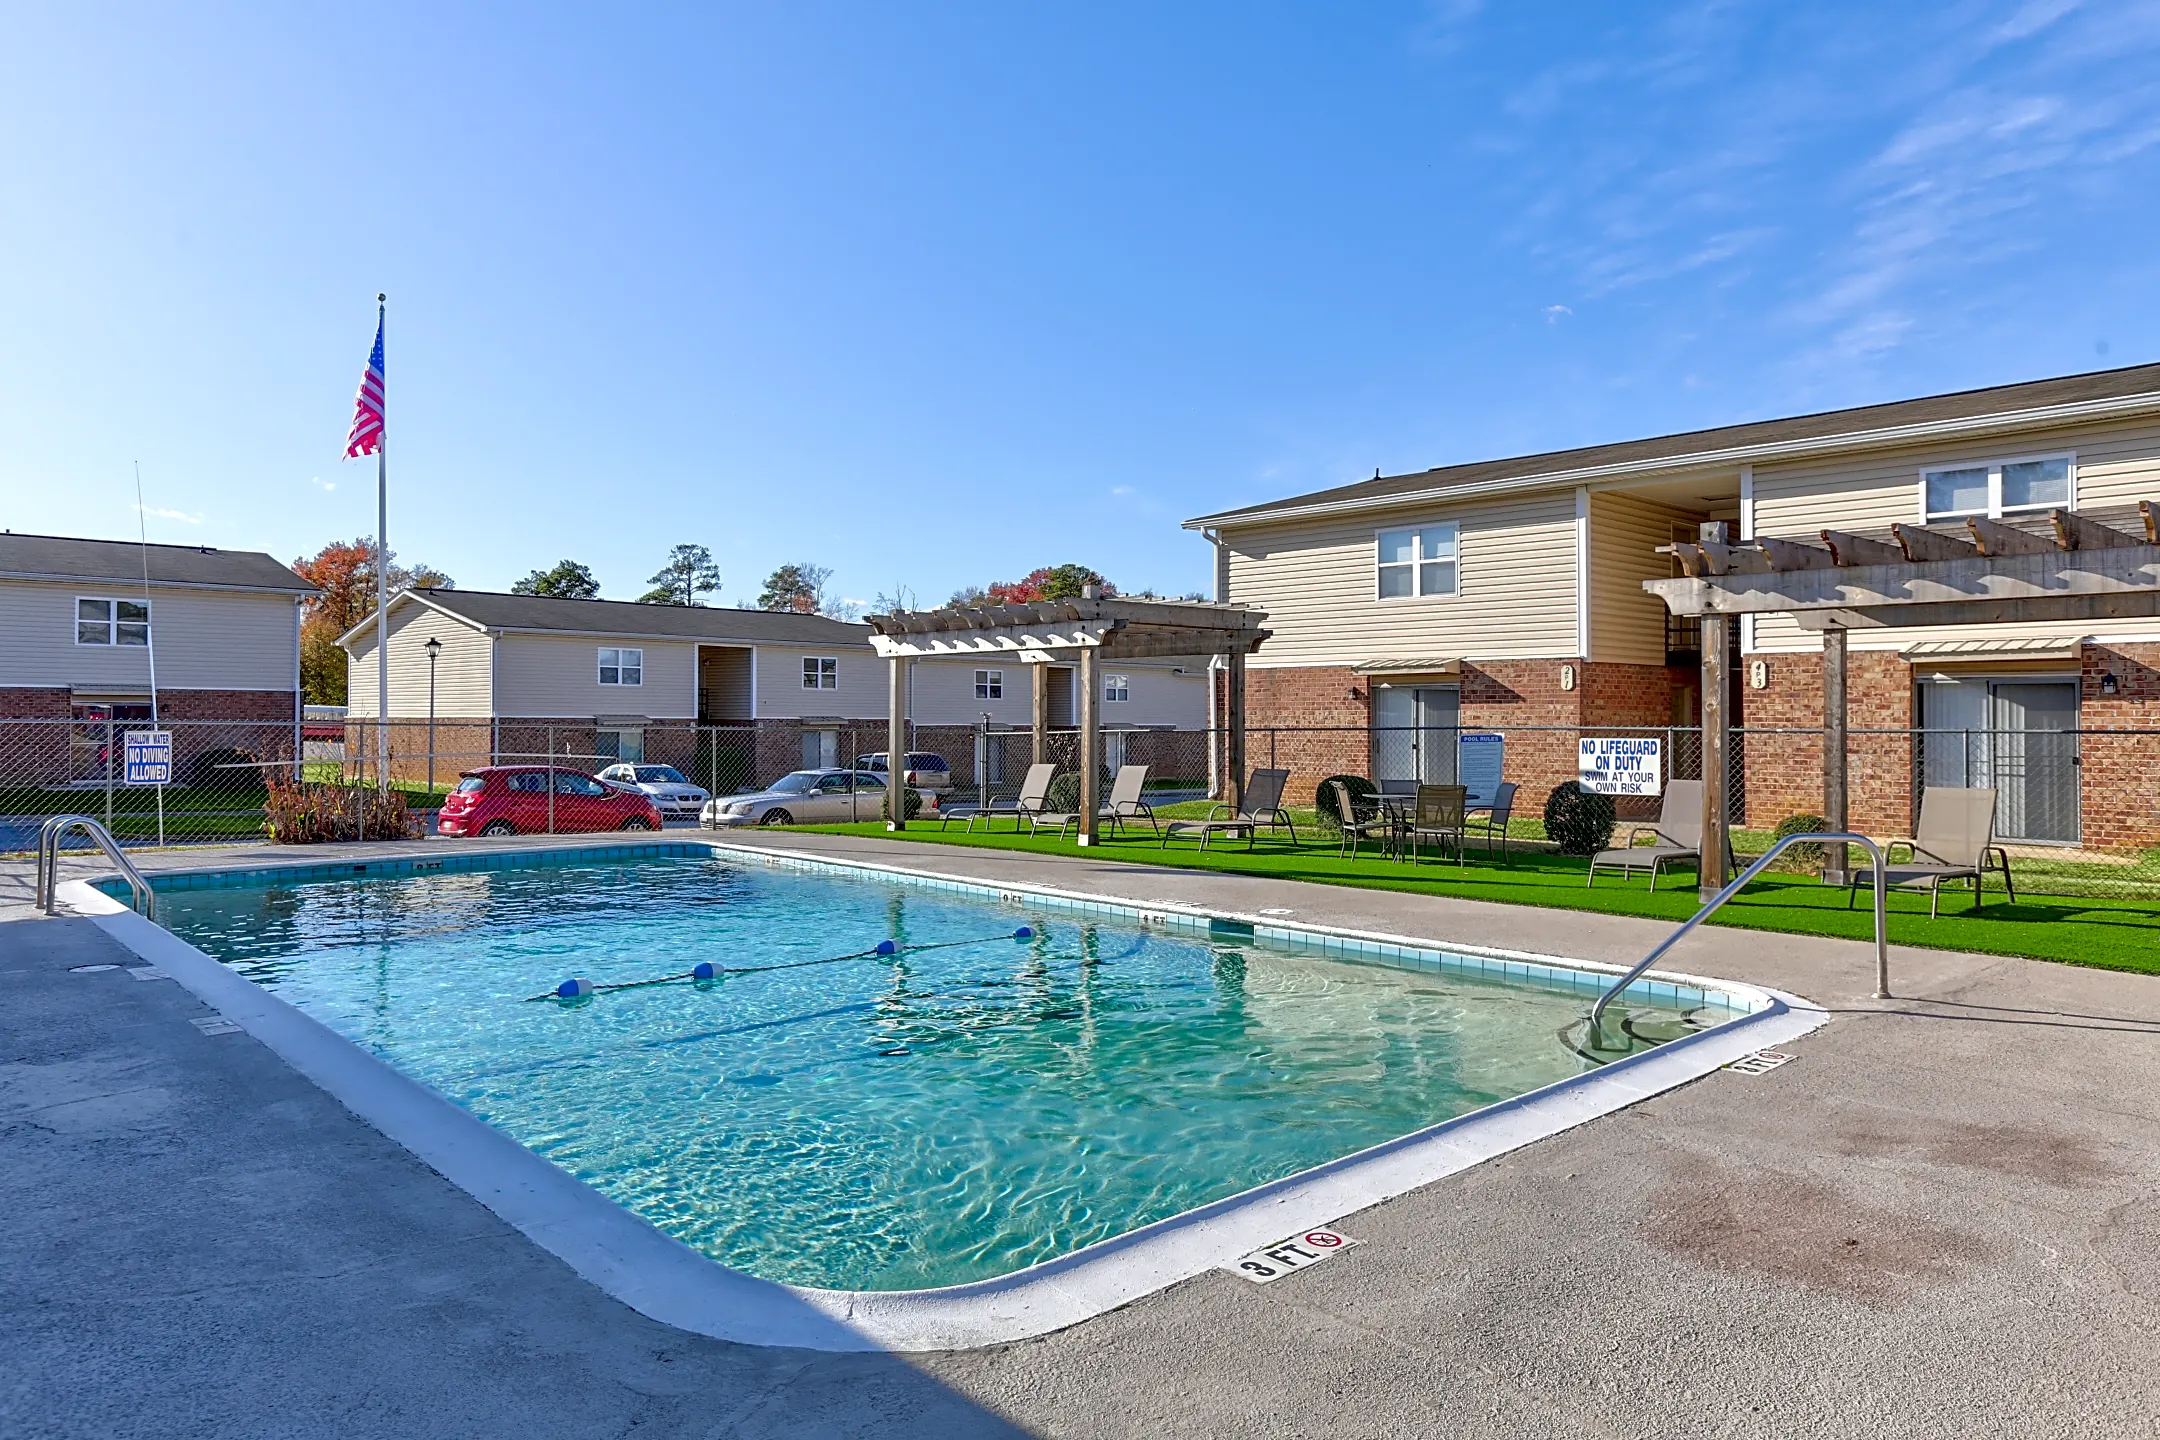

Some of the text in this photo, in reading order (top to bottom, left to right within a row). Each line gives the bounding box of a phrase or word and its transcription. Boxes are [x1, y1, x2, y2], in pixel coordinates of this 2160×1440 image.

[1564, 666, 1570, 674] 2
[128, 734, 169, 744] SHALLOW WATER
[129, 747, 168, 763] NO DIVING
[1581, 740, 1658, 755] NO LIFEGUARD
[1595, 756, 1642, 771] ON DUTY
[130, 765, 167, 780] ALLOWED
[1585, 771, 1654, 783] SWIM AT YOUR
[1595, 782, 1642, 793] OWN RISK
[1240, 1261, 1277, 1277] 3
